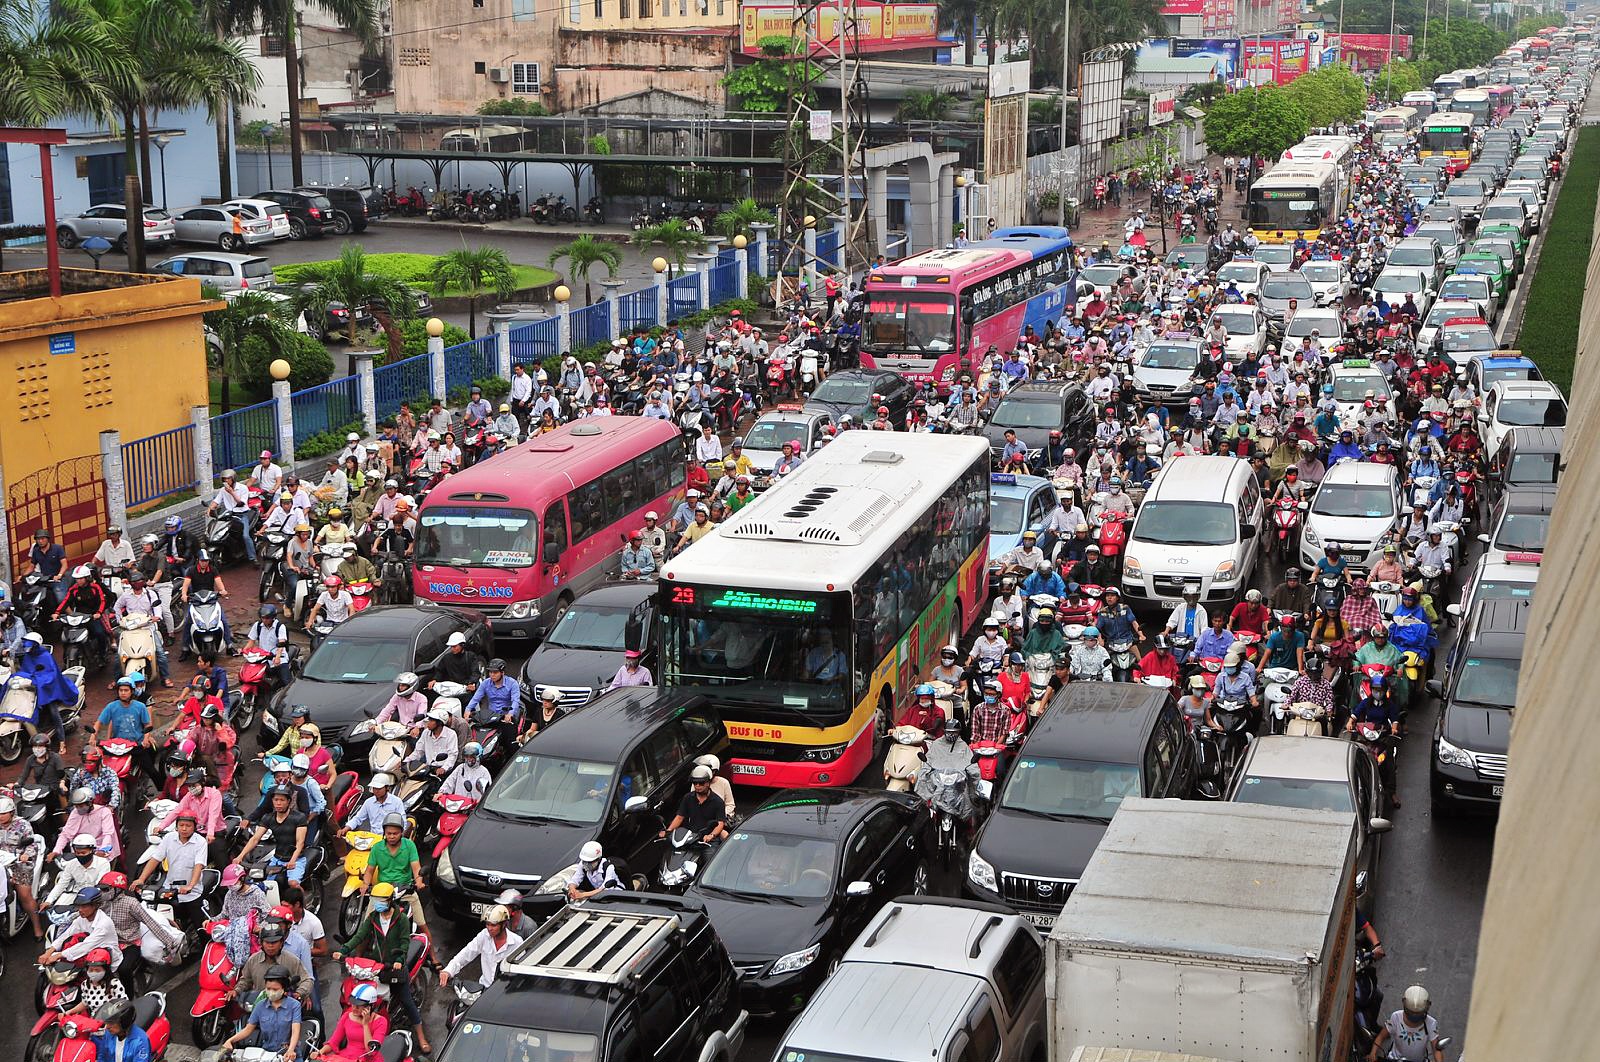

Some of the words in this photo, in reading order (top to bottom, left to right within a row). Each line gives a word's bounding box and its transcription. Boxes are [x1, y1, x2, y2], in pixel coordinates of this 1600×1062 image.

[429, 581, 461, 597] NGỌC
[672, 586, 694, 604] 29
[730, 726, 751, 737] BUS
[753, 728, 764, 738] 10
[771, 729, 782, 739] 10
